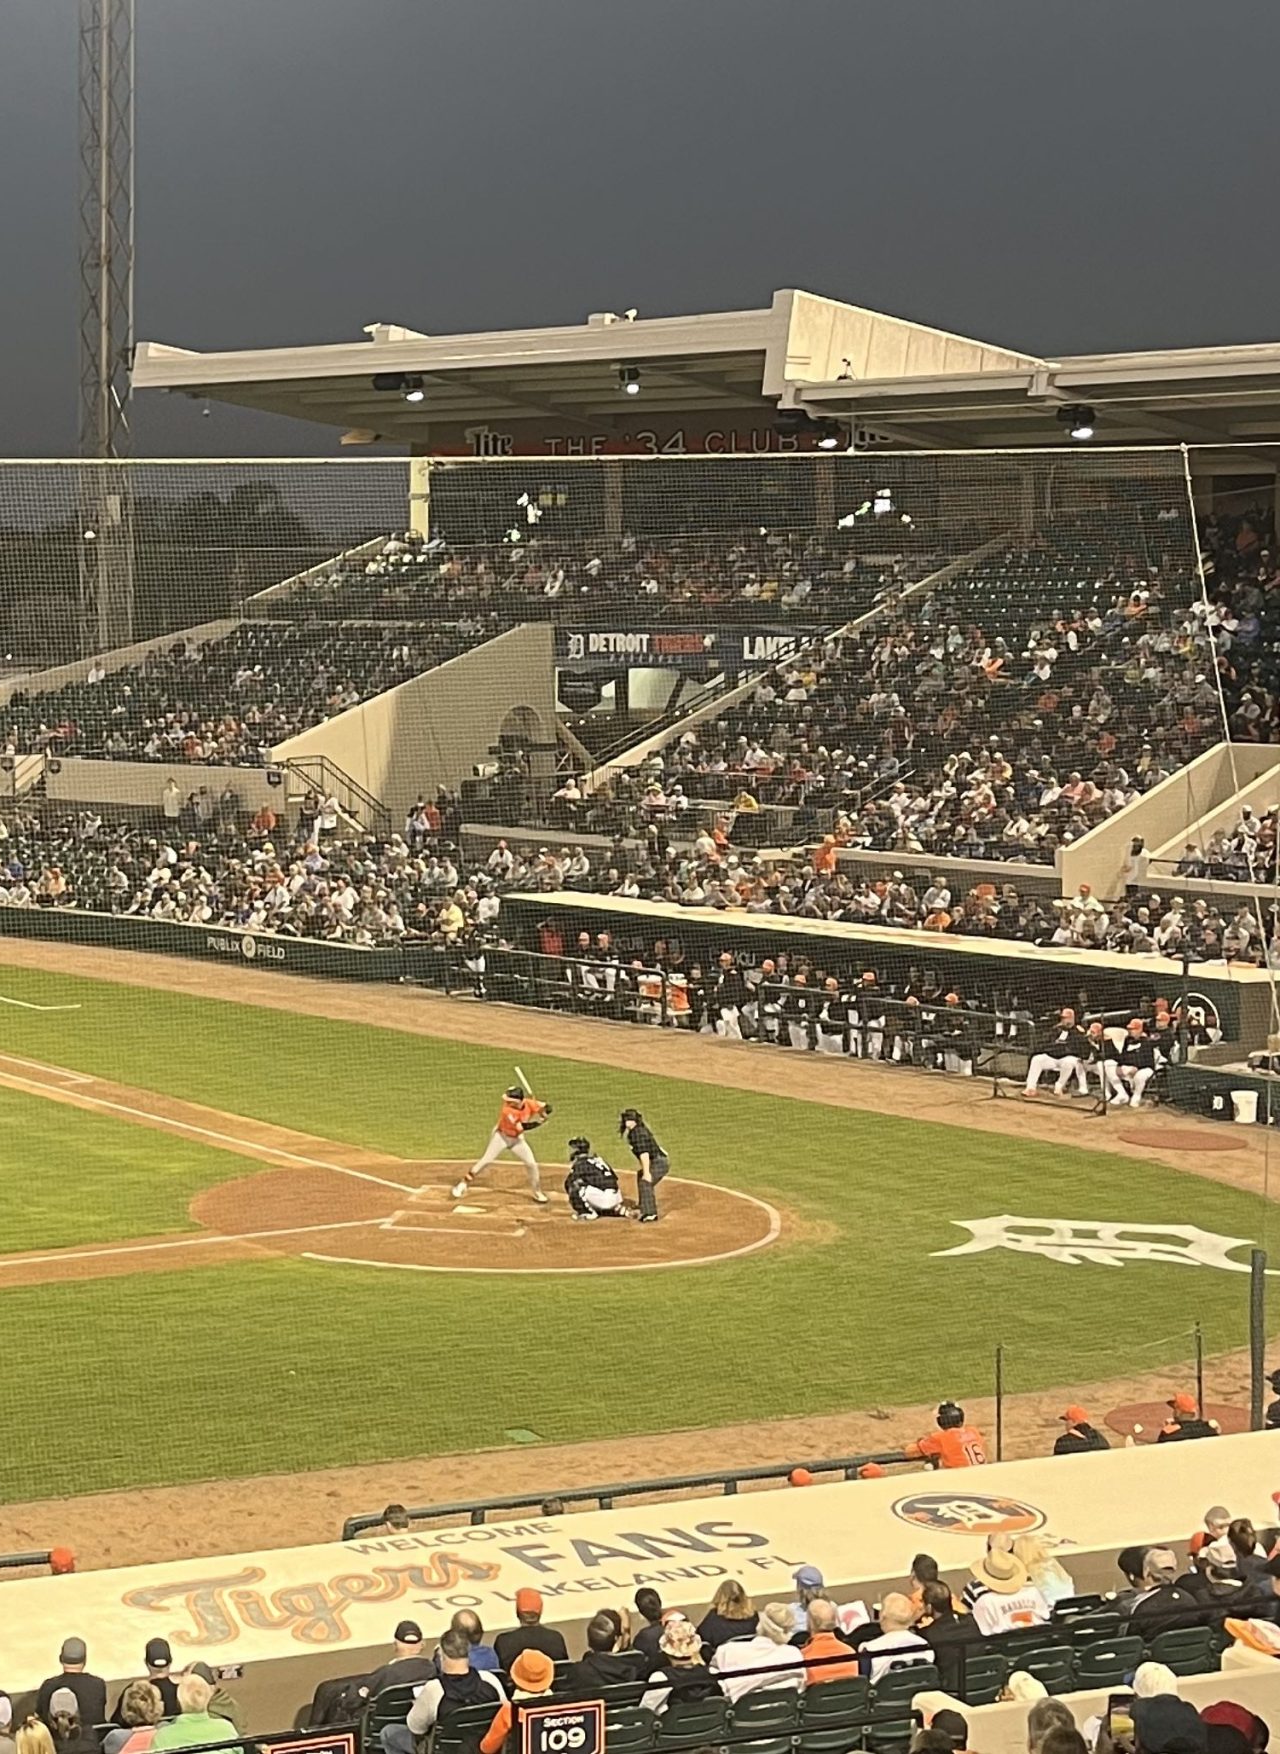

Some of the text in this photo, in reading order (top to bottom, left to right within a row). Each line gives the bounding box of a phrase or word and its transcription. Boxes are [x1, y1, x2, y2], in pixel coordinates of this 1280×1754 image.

[545, 436, 607, 455] THE
[704, 429, 799, 453] CLUB
[589, 632, 650, 653] DETROIT
[207, 936, 241, 953] PUBLIX
[257, 943, 285, 959] FIELD
[963, 1442, 986, 1466] 16
[345, 1521, 563, 1556] WELCOME
[122, 1521, 770, 1647] Tigers FANS
[413, 1593, 484, 1612] TO
[748, 1554, 806, 1571] FL
[541, 1726, 586, 1752] 109
